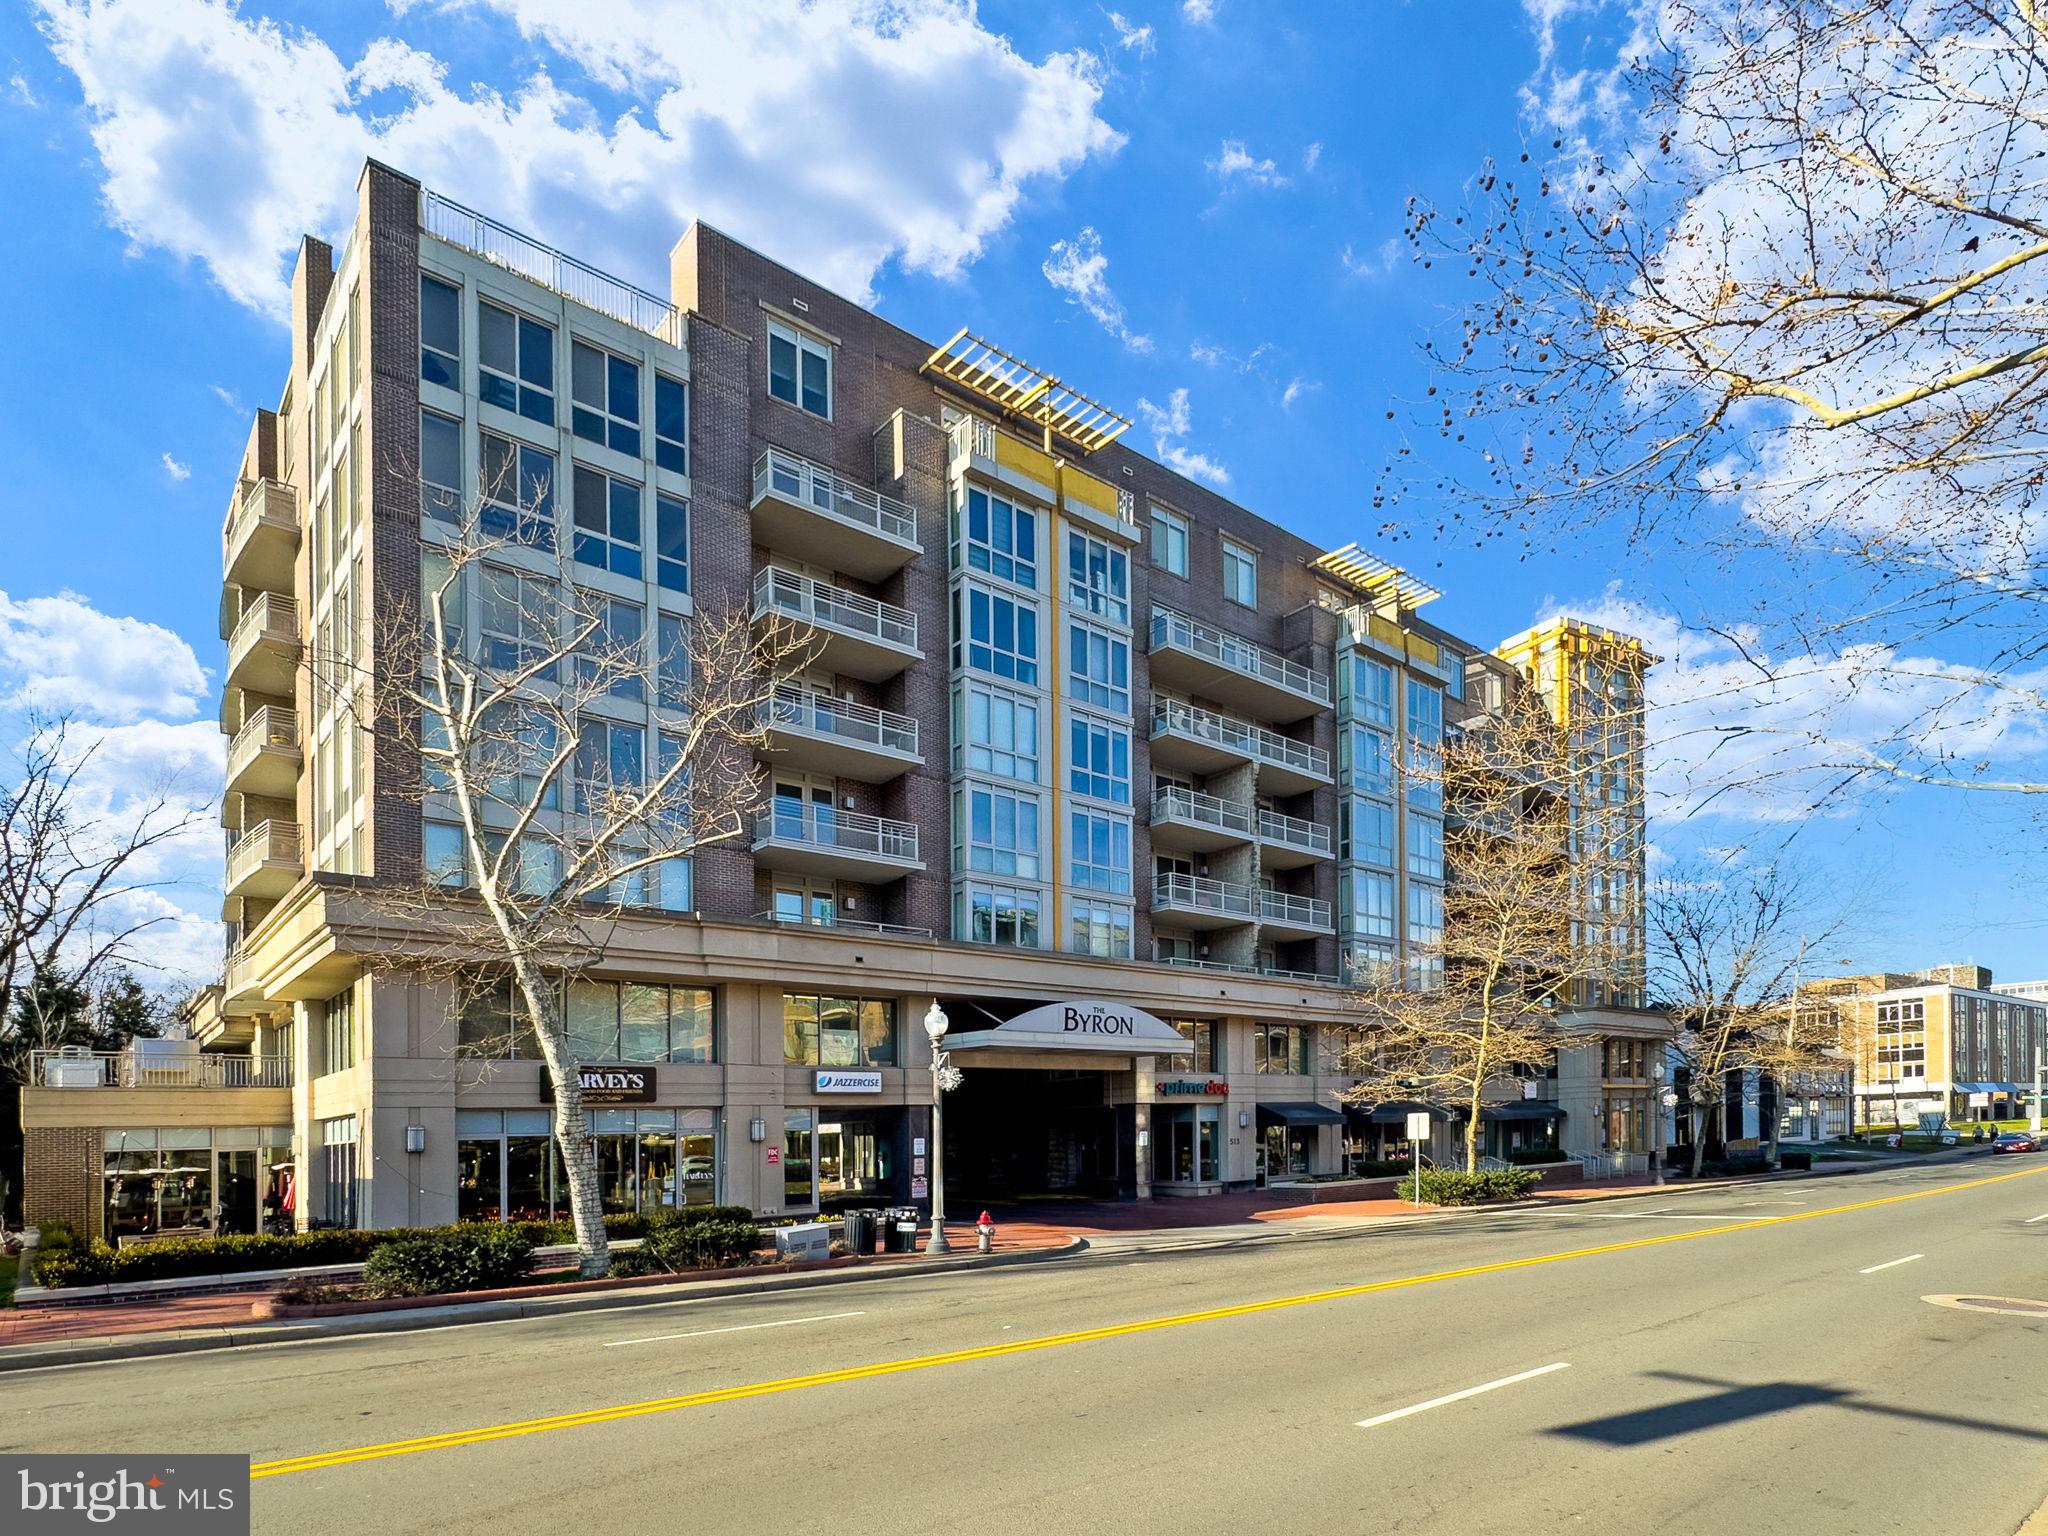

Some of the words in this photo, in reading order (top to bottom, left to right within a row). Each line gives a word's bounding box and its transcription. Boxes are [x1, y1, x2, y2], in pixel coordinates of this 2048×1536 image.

[1093, 1006, 1106, 1014] THE
[1063, 1007, 1133, 1035] BYRON
[577, 1073, 645, 1089] ARVEY'S
[833, 1078, 880, 1087] JAZZERCISE
